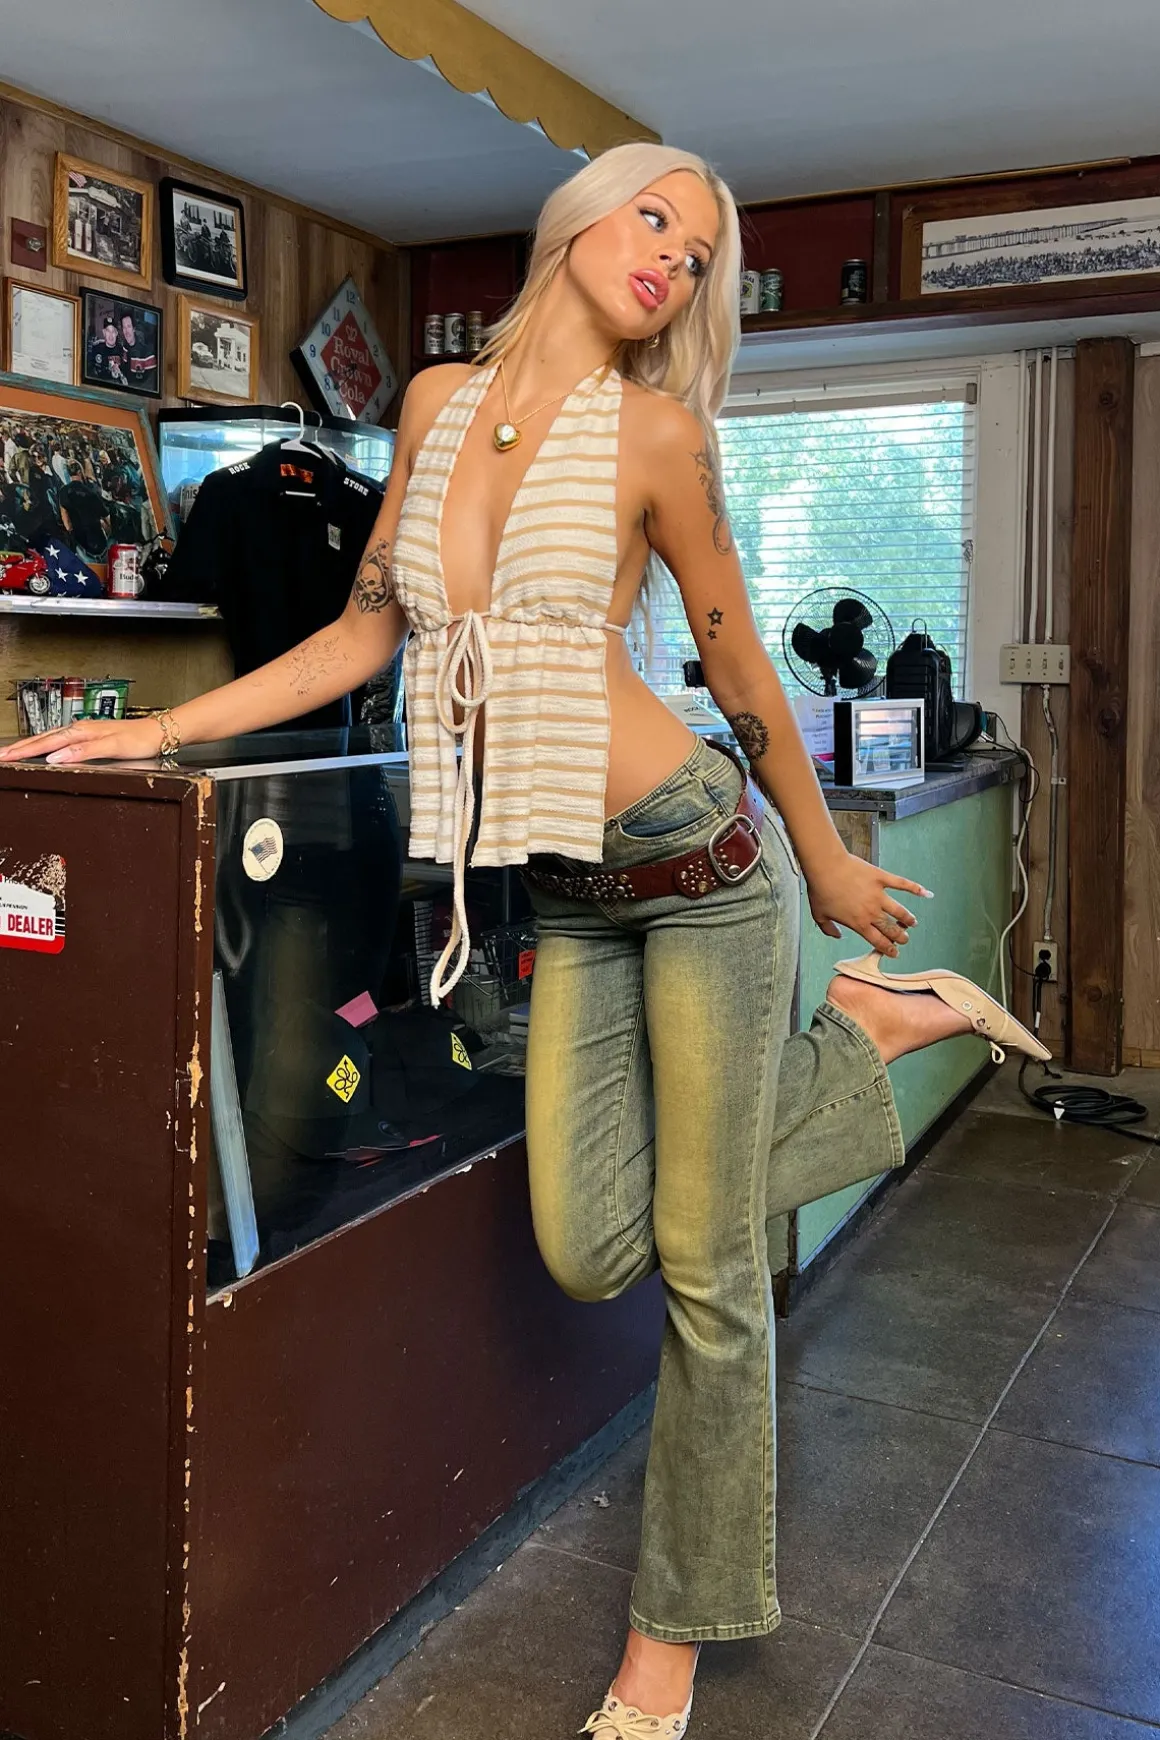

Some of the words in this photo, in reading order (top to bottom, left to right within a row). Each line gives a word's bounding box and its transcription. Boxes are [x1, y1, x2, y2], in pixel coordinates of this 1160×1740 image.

[346, 290, 356, 304] 12
[333, 307, 341, 321] 11
[321, 322, 331, 336] 10
[309, 344, 317, 358] 9
[333, 336, 370, 366] Royal
[372, 345, 379, 357] 2
[324, 375, 331, 391] 8
[386, 376, 392, 389] 3
[338, 380, 366, 405] Cola
[228, 462, 251, 475] ROCK
[343, 477, 369, 496] STORE
[8, 914, 53, 936] DEALER
